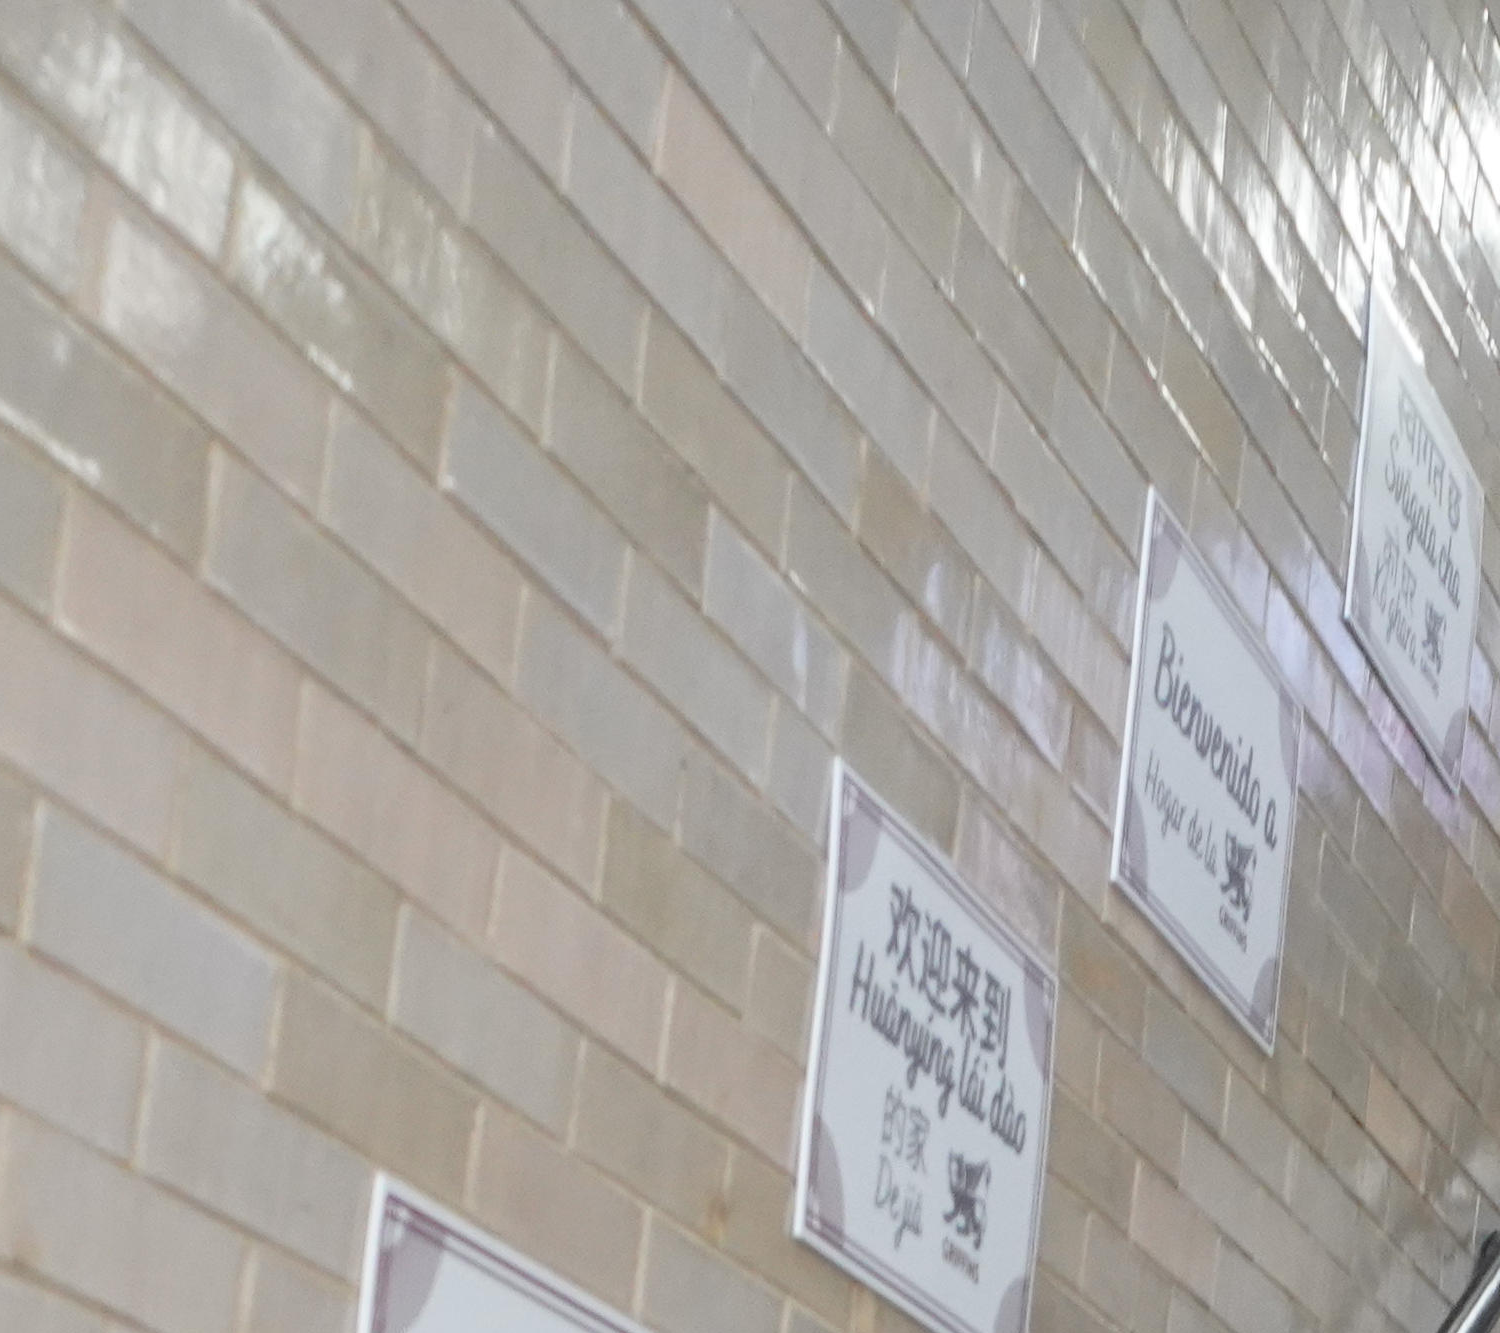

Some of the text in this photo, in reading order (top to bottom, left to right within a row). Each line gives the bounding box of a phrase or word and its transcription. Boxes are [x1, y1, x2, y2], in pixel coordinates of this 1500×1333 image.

[1153, 621, 1261, 827] Bienvenido
[1143, 748, 1186, 838] Hogar
[1186, 807, 1203, 860] de
[885, 882, 1011, 1070] 欢迎来到
[880, 1085, 930, 1173] 的家
[873, 1153, 899, 1220] De
